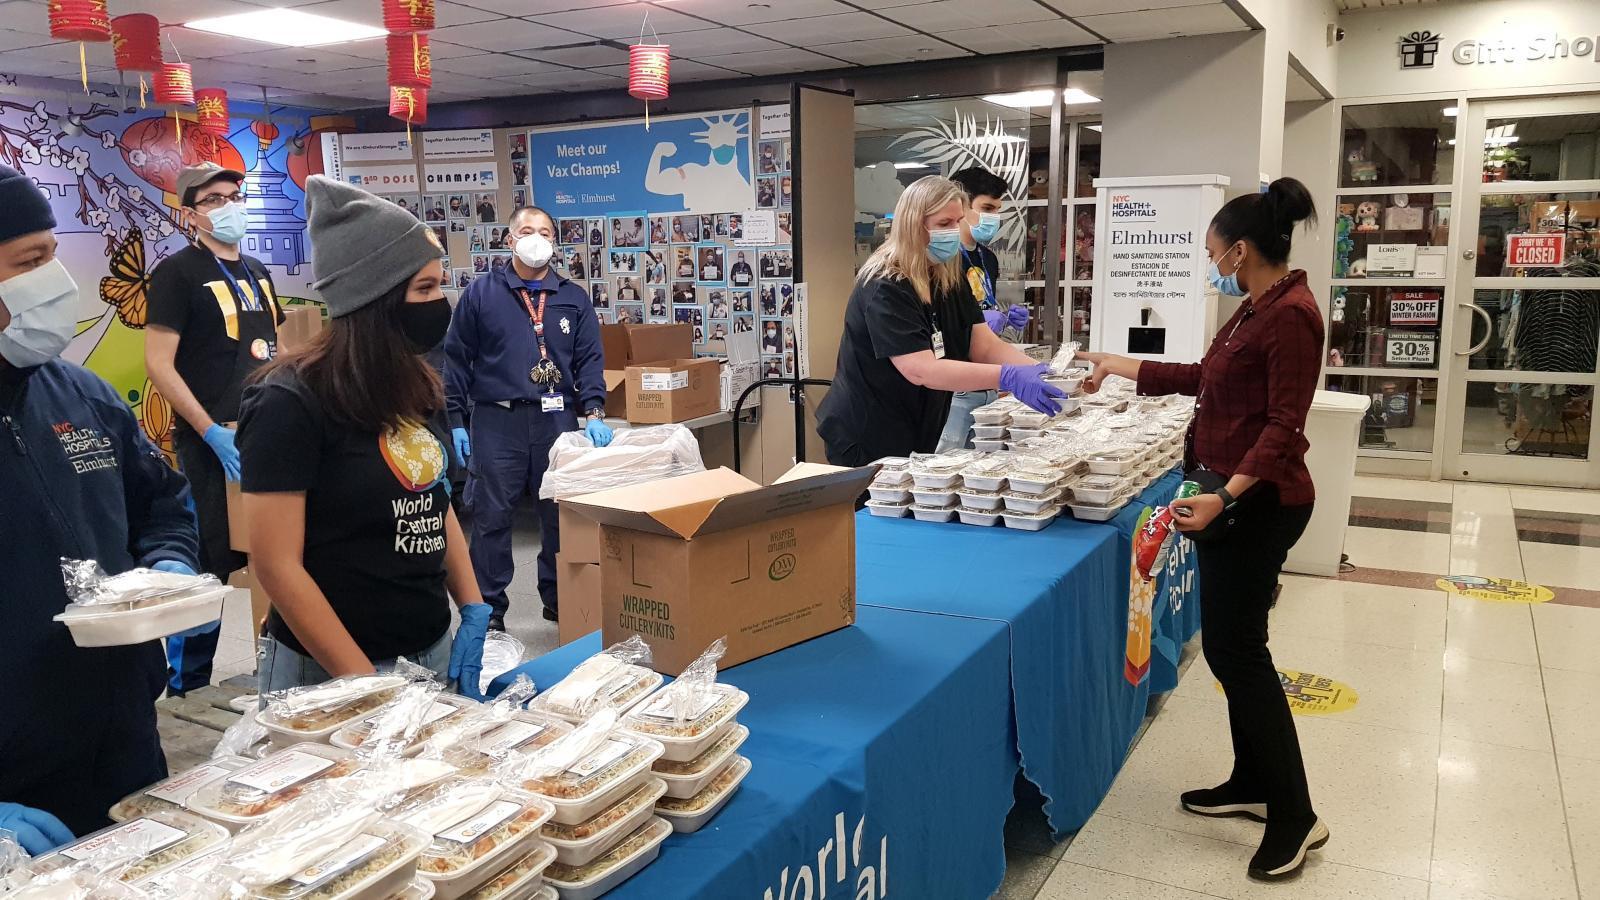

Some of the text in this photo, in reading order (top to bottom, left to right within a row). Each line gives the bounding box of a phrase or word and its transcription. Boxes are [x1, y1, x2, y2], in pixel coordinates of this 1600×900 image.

[557, 144, 607, 157] Meet our
[547, 161, 621, 178] Vax Champs!
[427, 173, 477, 183] CHAMPS
[581, 193, 617, 203] Elmhurst
[1112, 209, 1157, 217] HOSPITALS
[1111, 230, 1194, 245] Elmhurst
[1515, 247, 1556, 263] CLOSED
[1392, 302, 1436, 311] 30% OFF
[637, 393, 662, 402] WRAPPED
[51, 421, 74, 433] NYC
[63, 437, 111, 454] HOSPITALS
[72, 456, 118, 474] Elmhurst
[391, 493, 433, 518] World
[396, 512, 443, 534] Central
[770, 528, 795, 542] WRAPPED
[394, 533, 446, 554] Kitchen
[622, 592, 670, 620] WRAPPED
